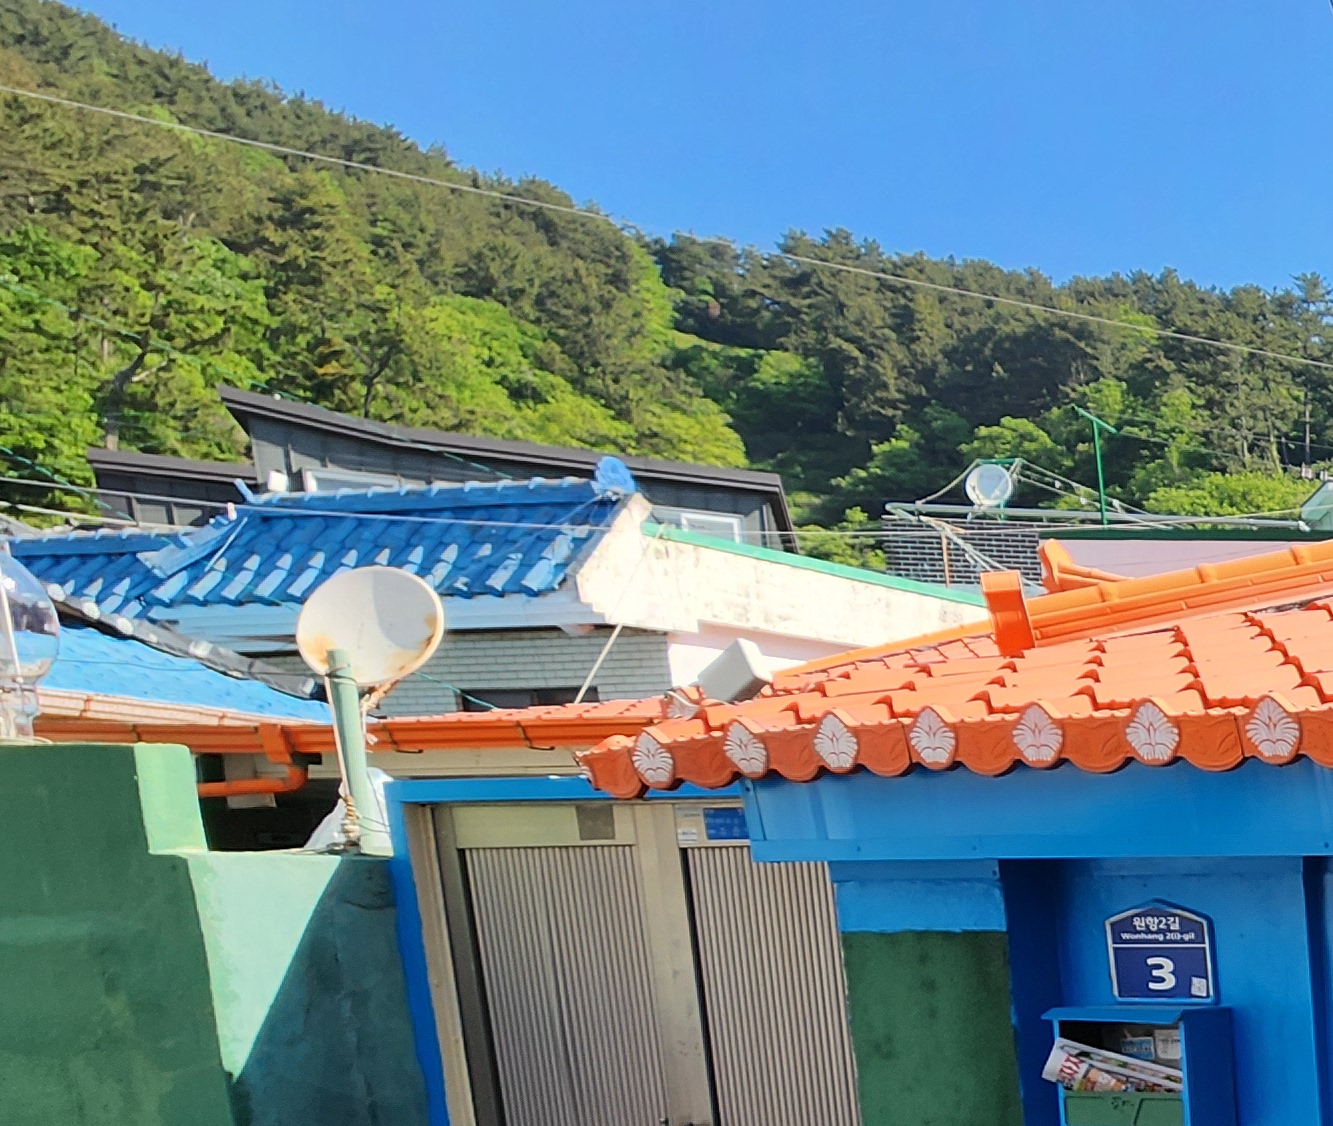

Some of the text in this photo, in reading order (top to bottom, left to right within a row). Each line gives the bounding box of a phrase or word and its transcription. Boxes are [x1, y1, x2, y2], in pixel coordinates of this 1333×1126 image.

[1132, 916, 1180, 931] 원항2길
[1120, 932, 1164, 941] Wonhang
[1146, 957, 1176, 990] 3
